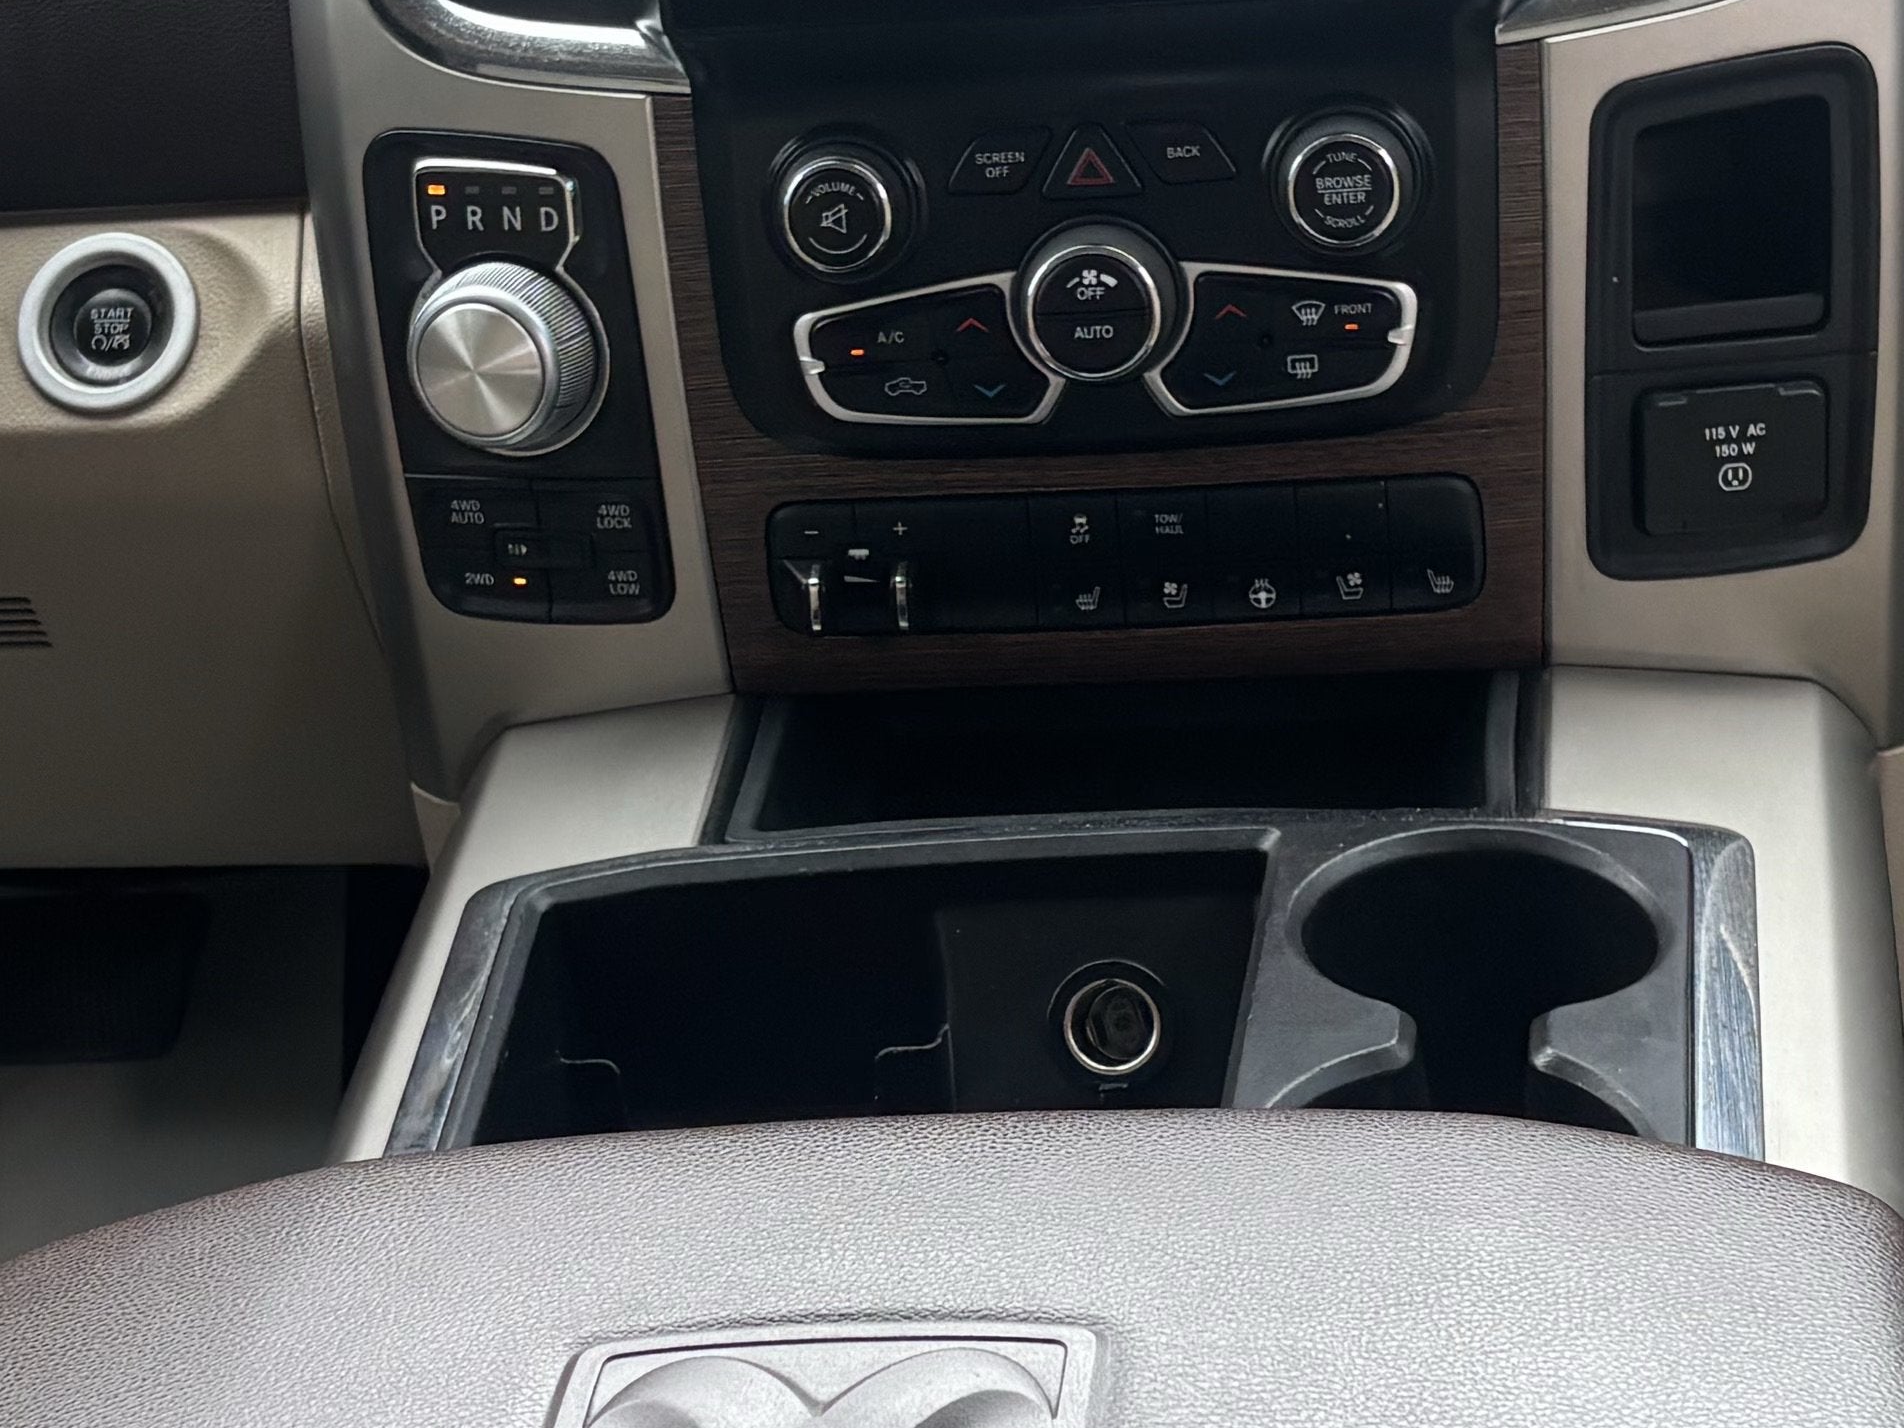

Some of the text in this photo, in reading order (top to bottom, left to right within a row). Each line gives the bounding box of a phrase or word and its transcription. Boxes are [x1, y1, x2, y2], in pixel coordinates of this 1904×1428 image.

[975, 152, 1025, 165] SCREEN
[1167, 146, 1200, 159] BACK
[1327, 151, 1358, 164] TUNE
[985, 166, 1010, 178] OFF
[1315, 174, 1372, 190] BROWSE
[811, 182, 856, 197] VOLUME
[1324, 192, 1366, 205] ENTER
[431, 205, 559, 232] P R N D
[1324, 214, 1365, 228] SCROLL
[1076, 287, 1105, 300] OFF
[90, 307, 134, 320] START
[1334, 303, 1372, 314] FRONT
[94, 323, 129, 335] STOP
[1074, 325, 1114, 339] AUTO
[877, 331, 905, 343] A/C
[1705, 422, 1766, 441] 115 V AC
[1715, 441, 1756, 458] 150 W
[450, 499, 480, 511] 4WD
[598, 504, 630, 516] 4WD
[451, 511, 484, 524] AUTO
[597, 517, 632, 529] LOCK
[1070, 535, 1090, 544] OFF
[465, 573, 494, 585] 2WD
[608, 570, 638, 582] 4WD
[609, 583, 640, 595] LOW
